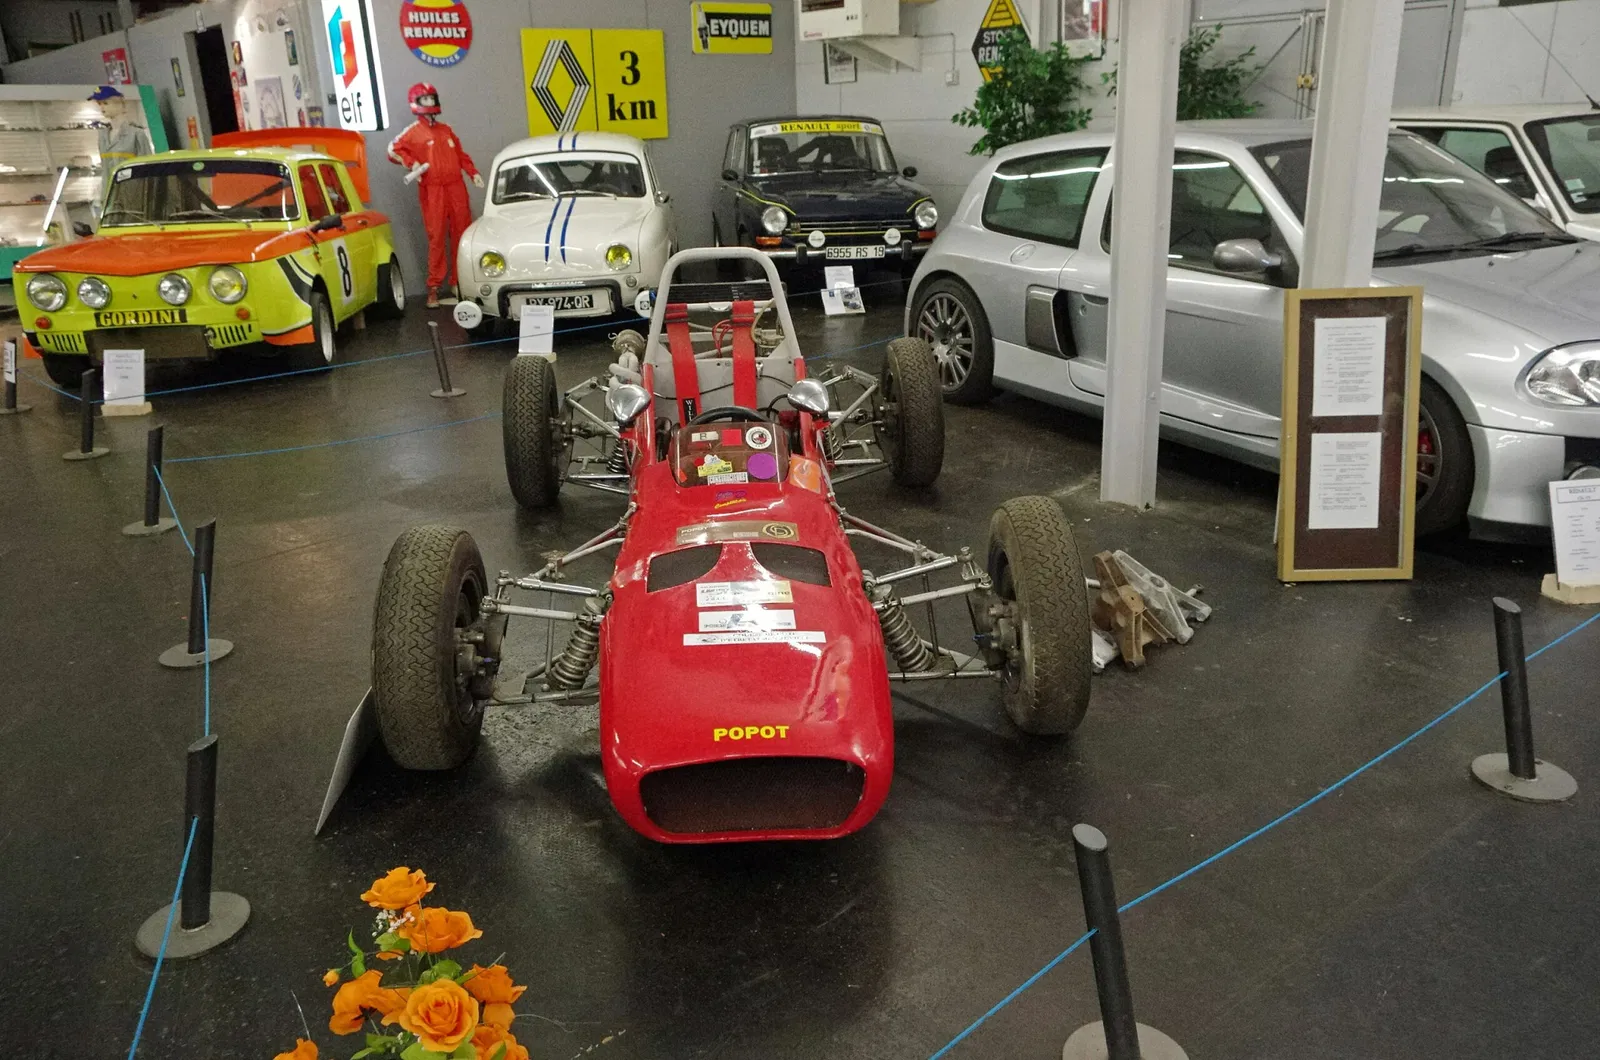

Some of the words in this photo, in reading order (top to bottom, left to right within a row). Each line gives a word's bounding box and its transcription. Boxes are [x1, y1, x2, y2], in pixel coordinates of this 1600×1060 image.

[408, 12, 460, 24] HUILES
[403, 27, 467, 38] RENAULT
[710, 18, 770, 38] EYQUEM
[420, 53, 460, 65] SERVICE
[619, 50, 641, 86] 3
[341, 92, 363, 124] elf
[606, 93, 658, 121] km
[781, 123, 831, 132] RENAULT
[836, 122, 861, 132] sport
[826, 247, 852, 258] 6955
[855, 247, 869, 258] RS
[873, 246, 885, 257] 19
[337, 246, 351, 297] 8
[100, 309, 181, 327] GORDINI
[713, 725, 790, 742] POPOT
